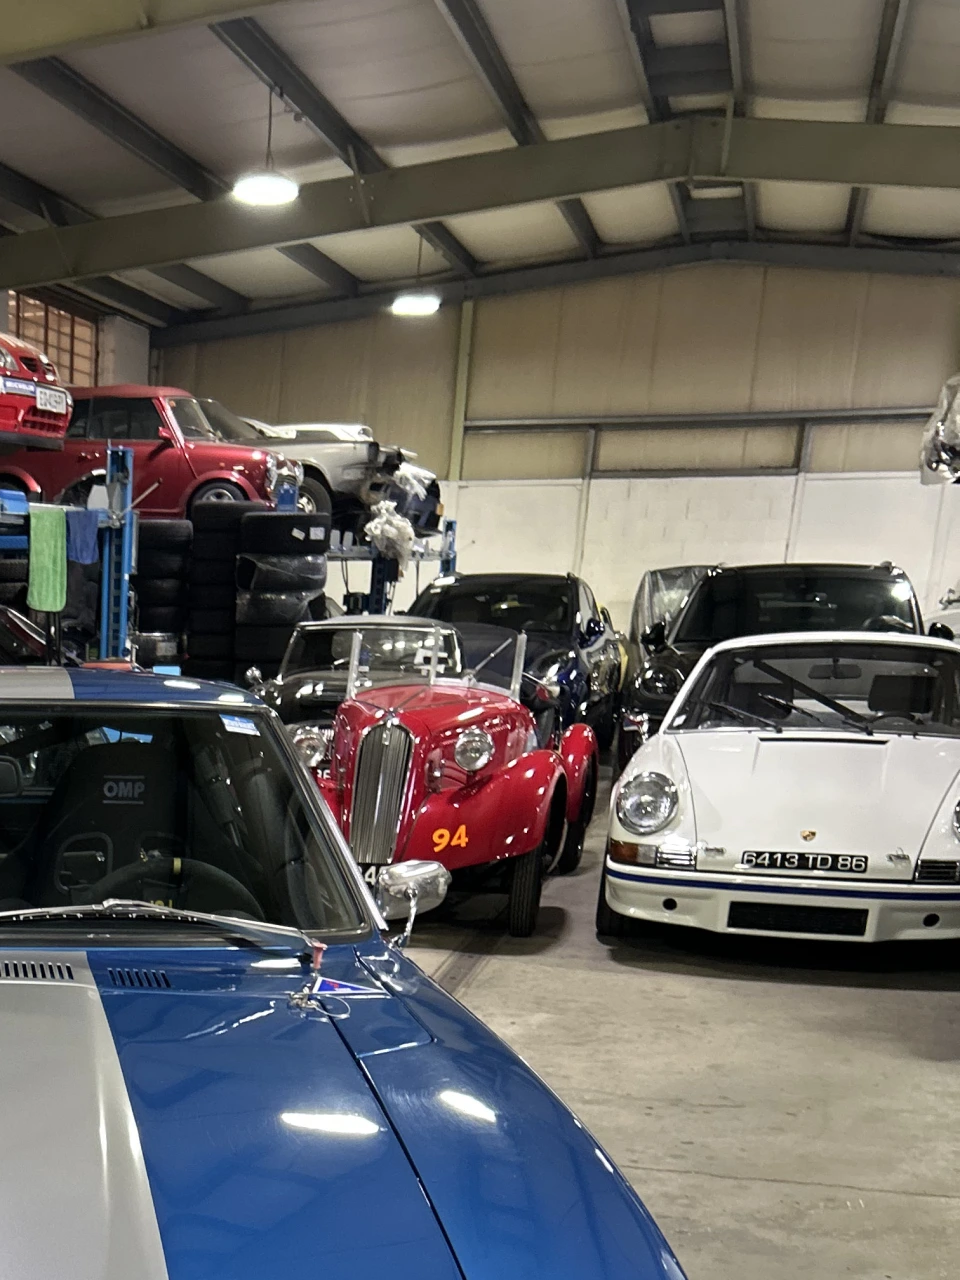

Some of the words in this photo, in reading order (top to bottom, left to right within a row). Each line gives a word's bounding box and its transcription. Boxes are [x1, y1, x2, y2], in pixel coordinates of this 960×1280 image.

[103, 781, 145, 798] OMP
[432, 824, 469, 853] 94
[742, 852, 799, 868] 6413
[804, 854, 832, 870] TD
[837, 856, 866, 871] 86
